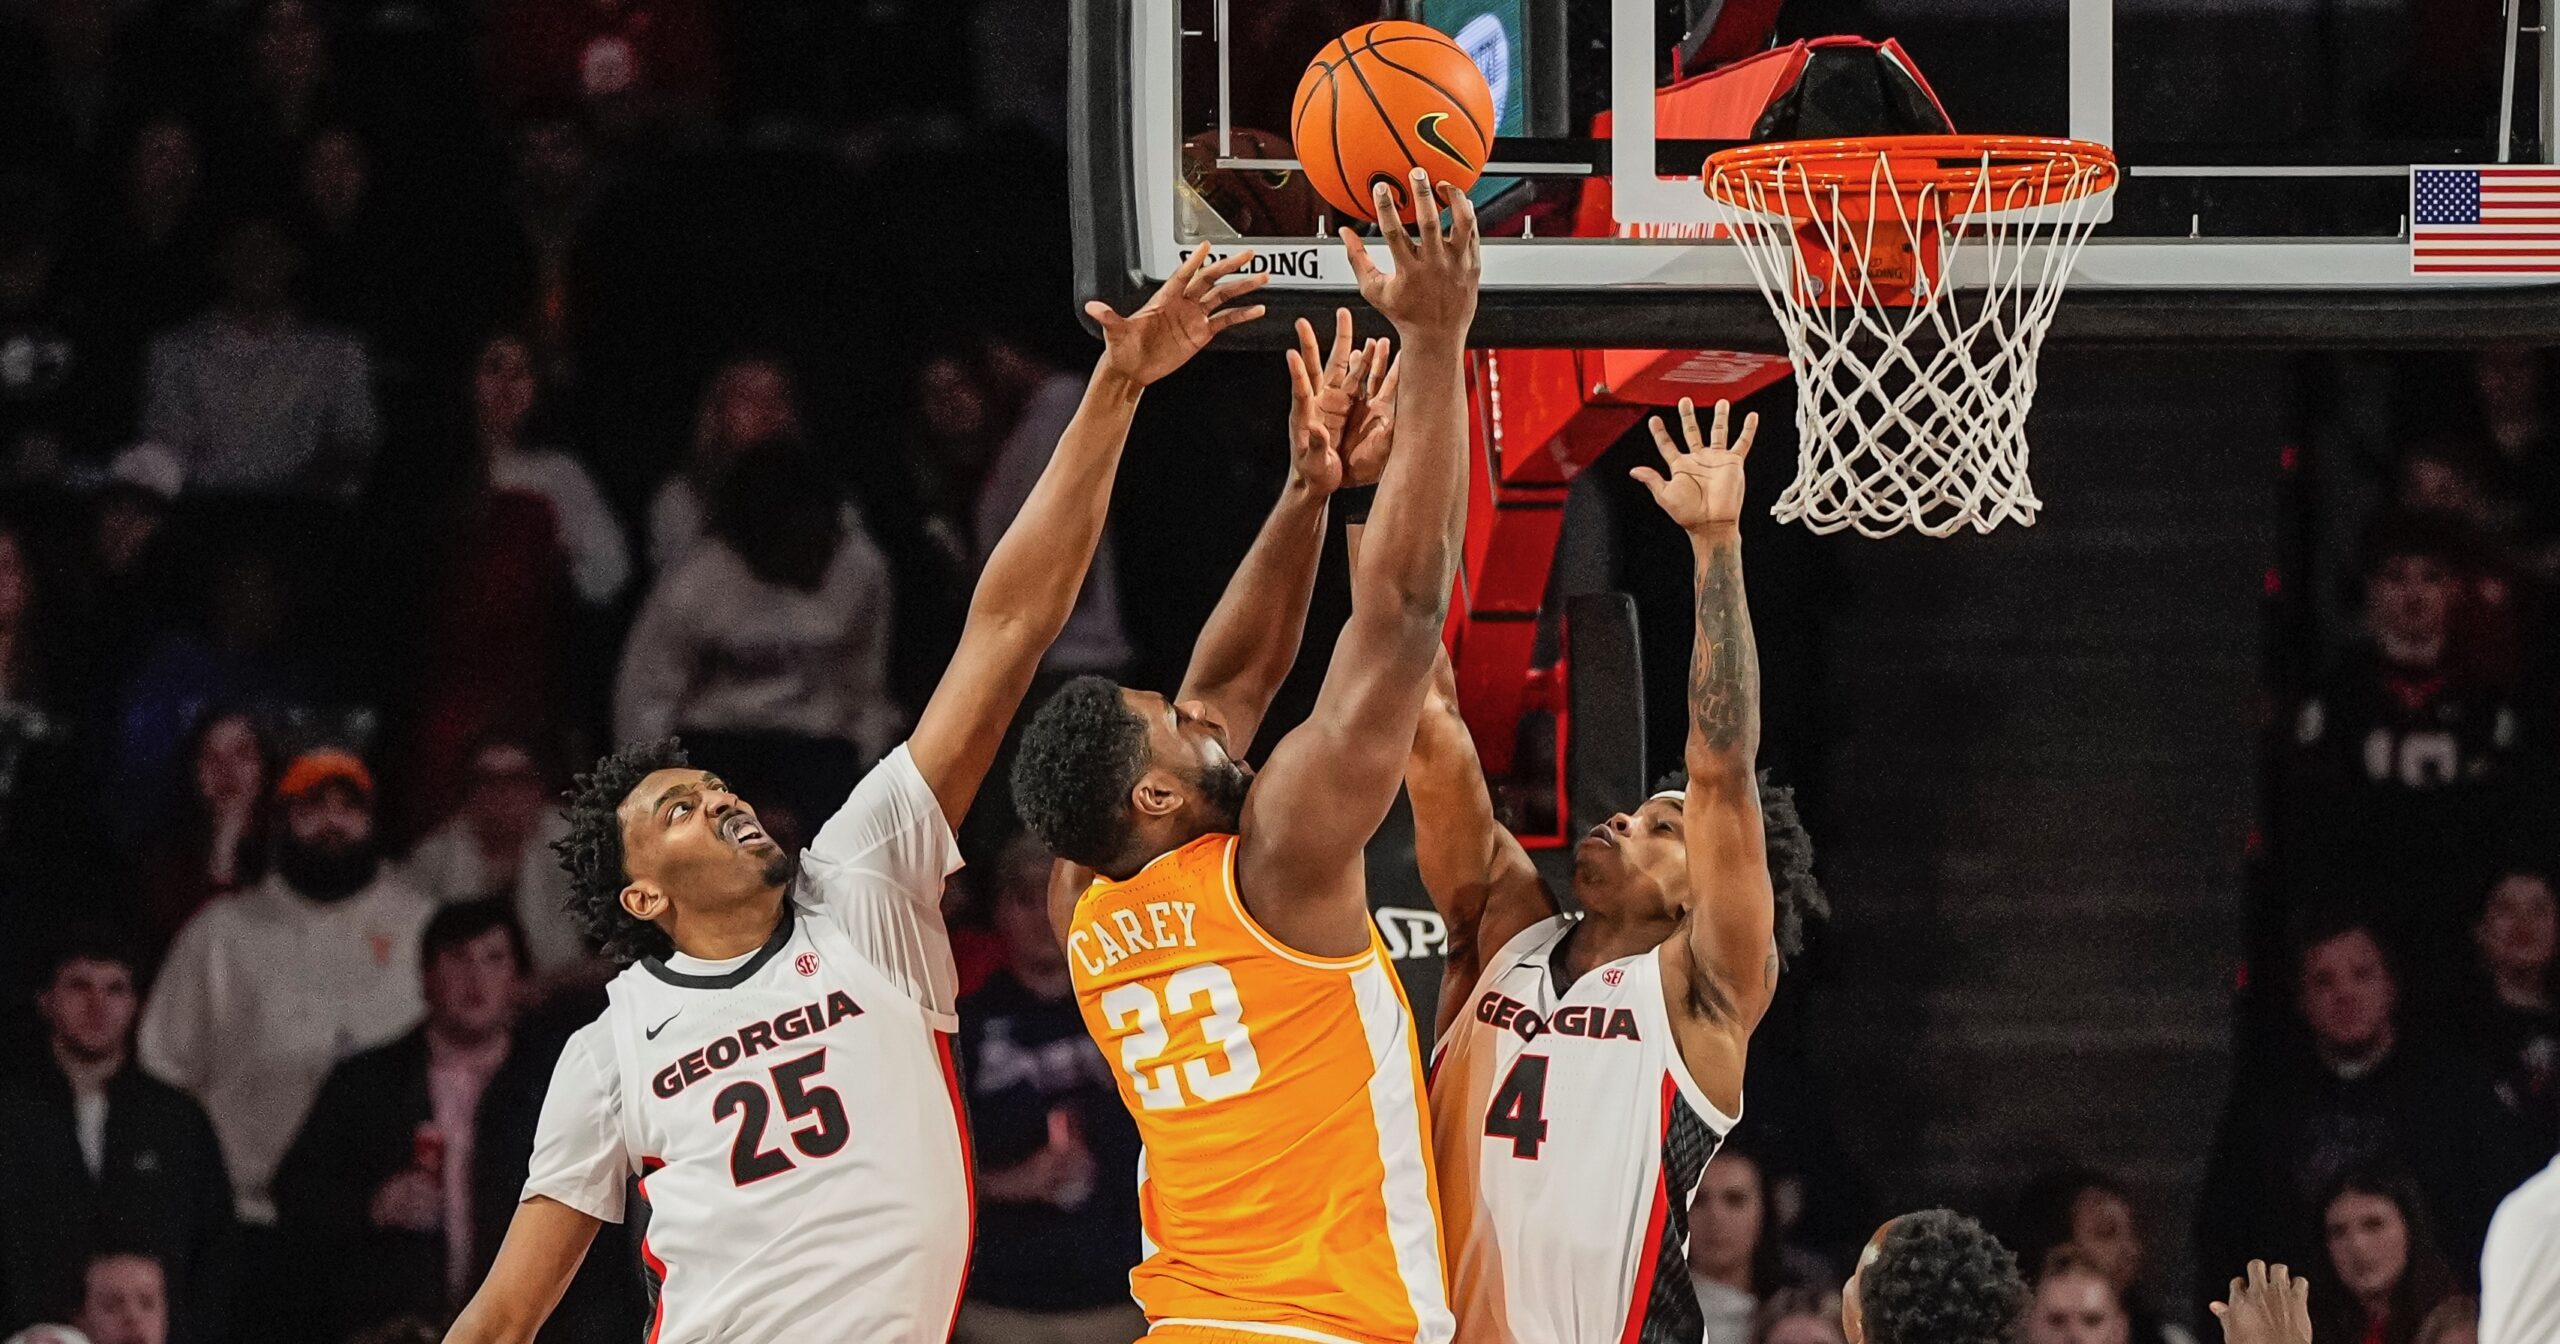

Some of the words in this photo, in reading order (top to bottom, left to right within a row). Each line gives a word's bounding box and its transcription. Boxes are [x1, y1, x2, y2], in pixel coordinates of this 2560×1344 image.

[1850, 267, 1905, 279] SPLDING
[797, 954, 818, 974] SEC
[1070, 900, 1197, 976] CAREY
[652, 990, 865, 1099] GEORGIA
[1101, 962, 1262, 1110] 23
[712, 1047, 850, 1187] 25
[1484, 1054, 1549, 1160] 4
